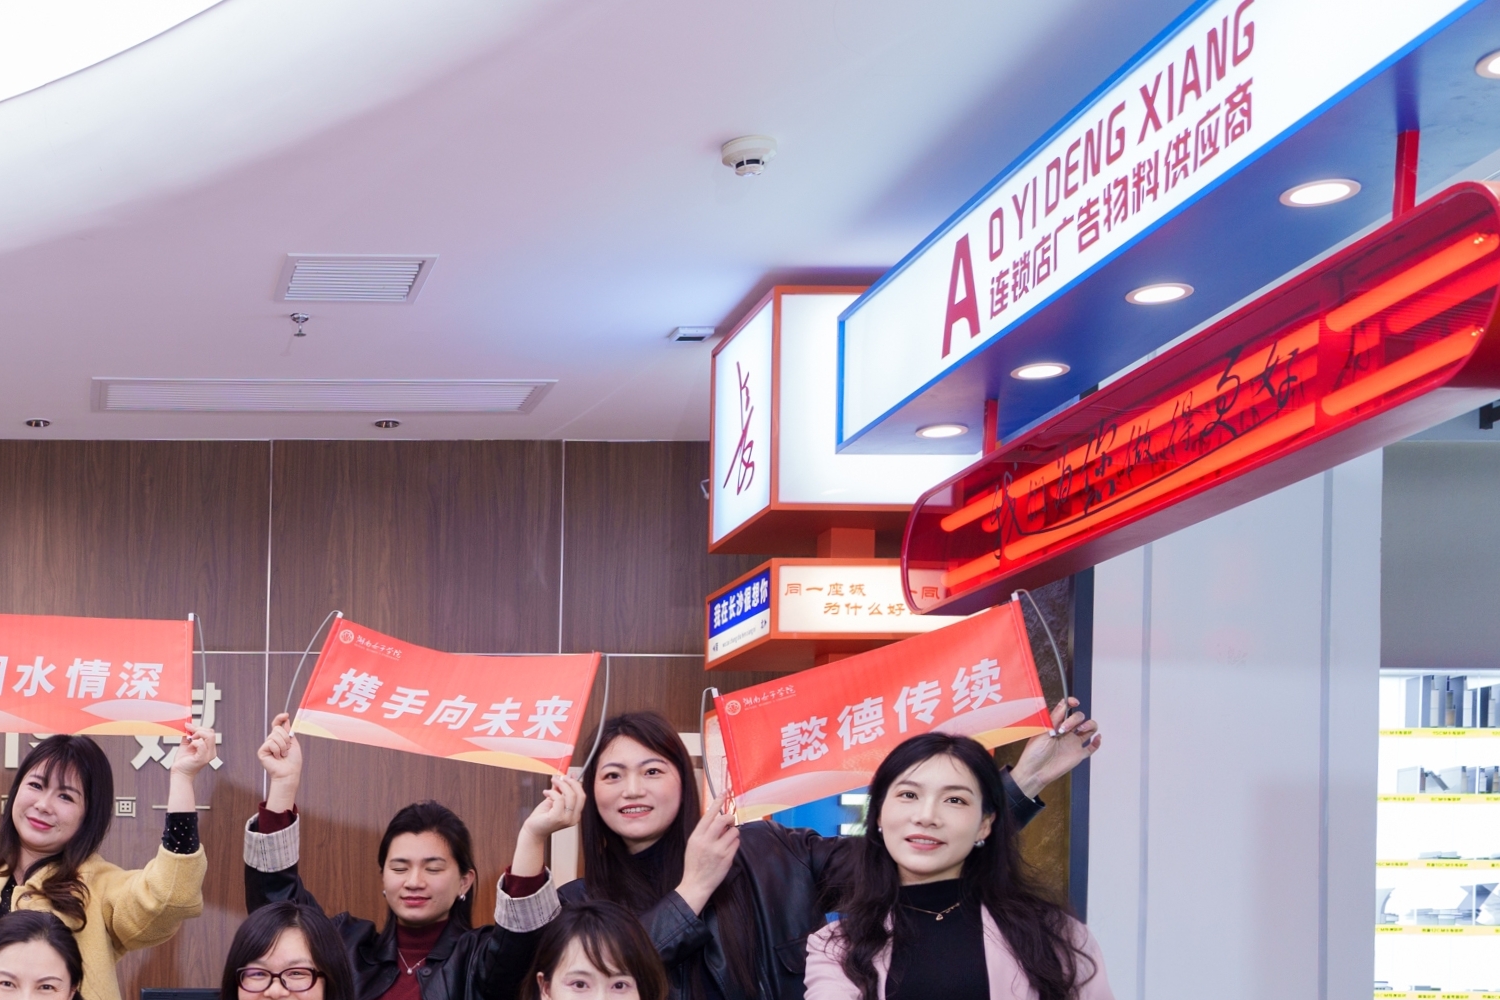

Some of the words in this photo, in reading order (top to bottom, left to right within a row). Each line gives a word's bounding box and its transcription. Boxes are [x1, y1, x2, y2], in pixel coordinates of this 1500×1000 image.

[1137, 0, 1255, 145] XIANG
[990, 77, 1253, 320] 连锁店广告物料供应商
[713, 578, 769, 629] 我在长沙很想你
[784, 582, 867, 597] 同一座城
[823, 602, 916, 616] 为什么好
[326, 667, 573, 740] 携手向未来
[780, 657, 1004, 769] 懿德传续
